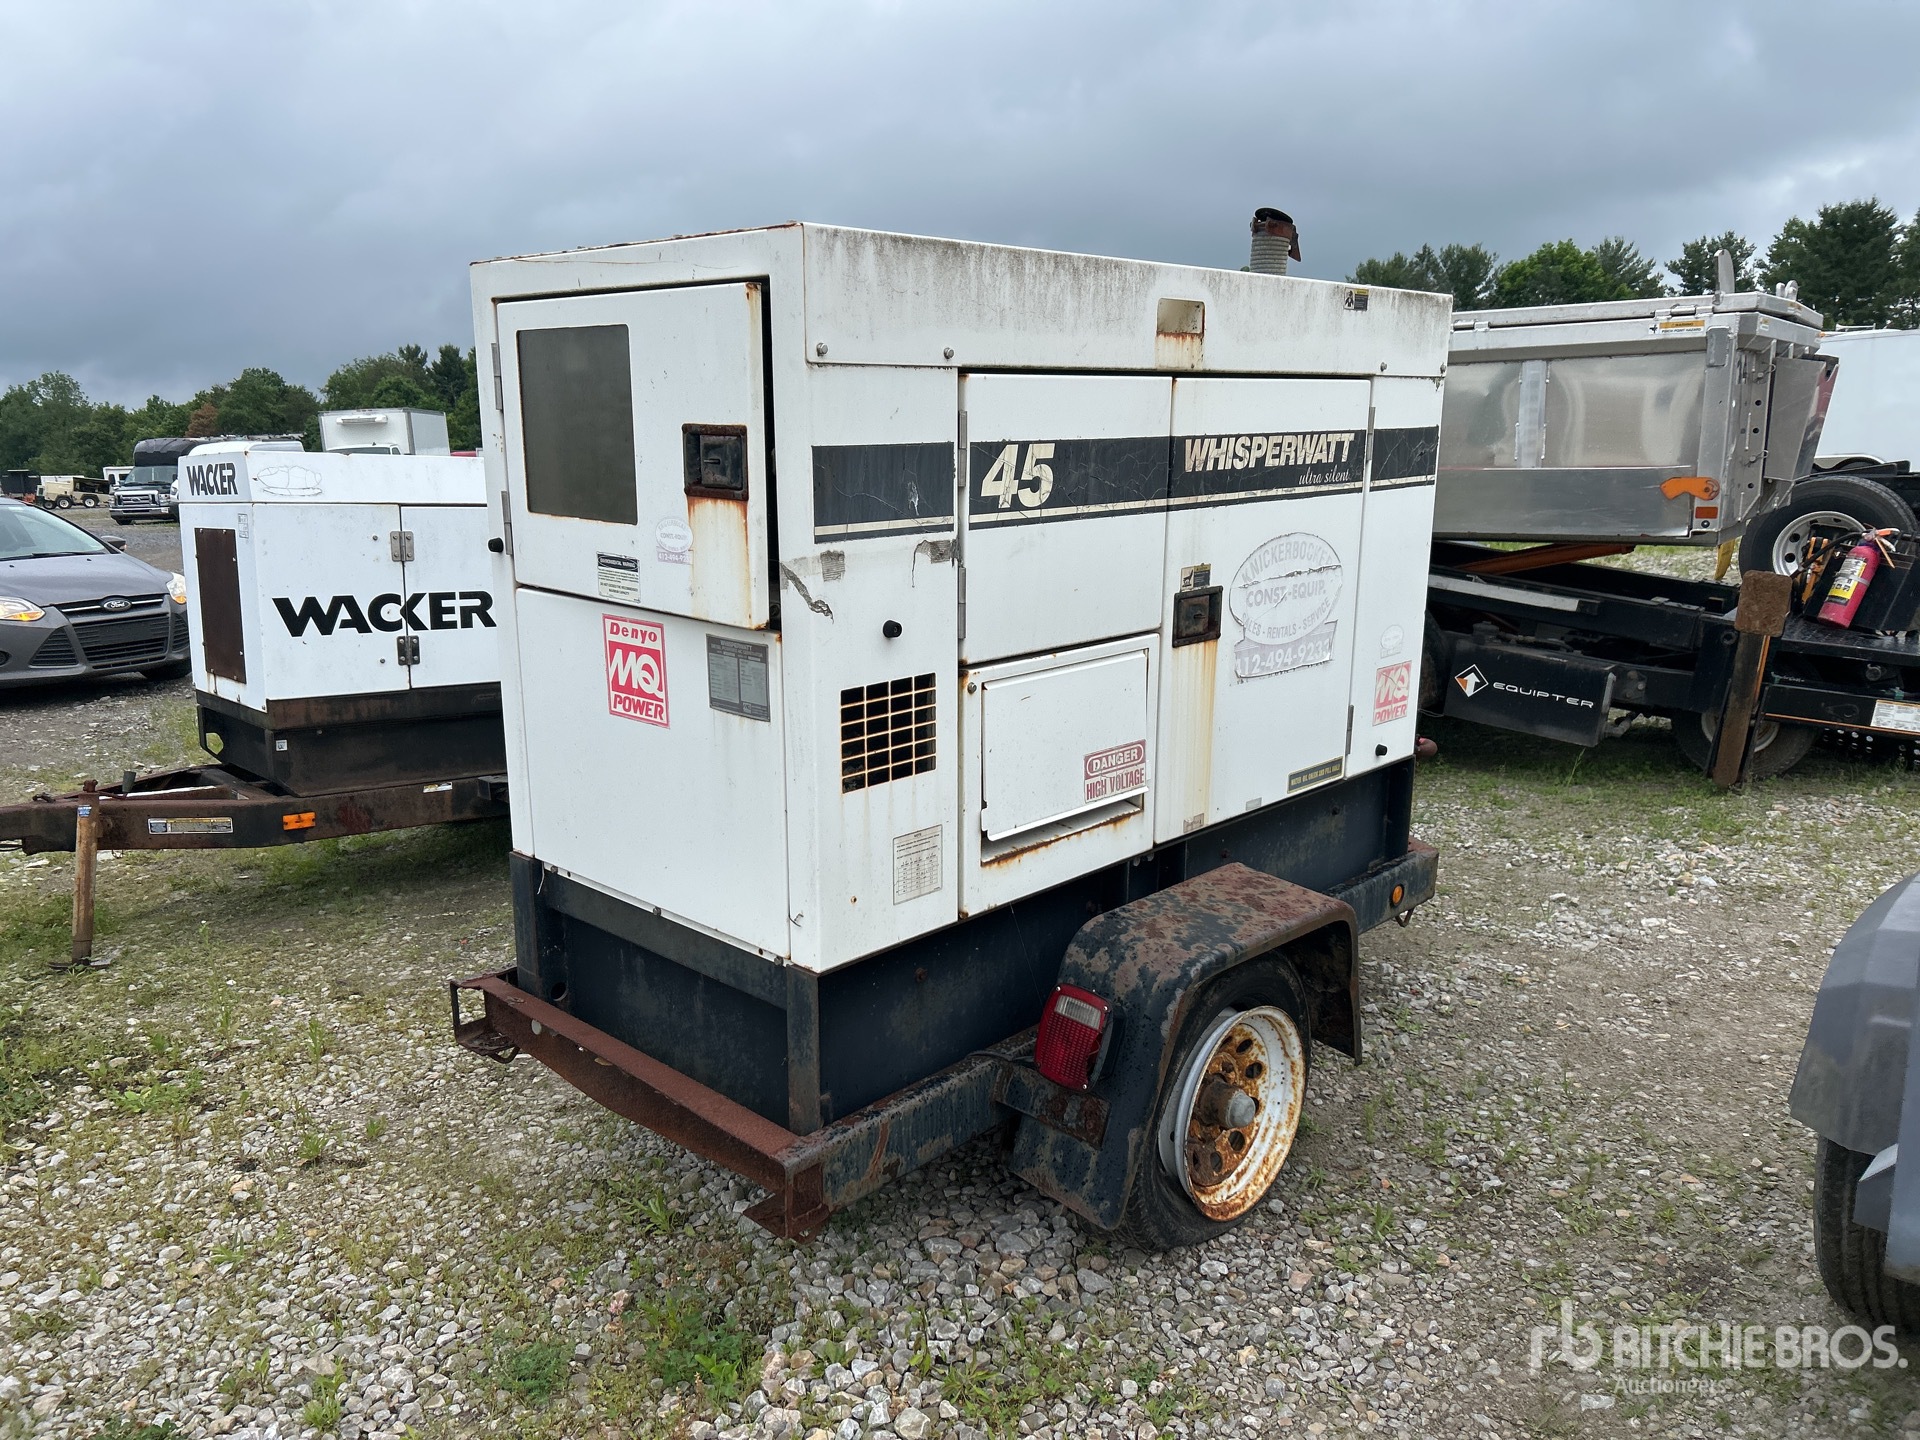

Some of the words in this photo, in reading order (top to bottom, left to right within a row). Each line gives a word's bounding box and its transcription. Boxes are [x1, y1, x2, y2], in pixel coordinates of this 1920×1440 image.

[1185, 432, 1355, 473] WHISPERWATT
[186, 462, 238, 496] WACKER
[980, 442, 1056, 509] 45
[1299, 466, 1323, 485] ultra
[1324, 464, 1350, 484] silent
[272, 590, 497, 638] WACKER
[1267, 623, 1297, 639] RENTALS
[1303, 596, 1331, 631] SERVICE
[610, 621, 658, 644] Denyo
[609, 648, 664, 701] MQ
[1375, 666, 1410, 703] MQ
[613, 693, 665, 721] POWER
[1493, 681, 1594, 709] EQUIPTER
[1374, 703, 1408, 722] POWER
[1092, 748, 1138, 772] DANGER
[1086, 777, 1107, 801] HIGH
[1109, 767, 1145, 793] VOLTAGE
